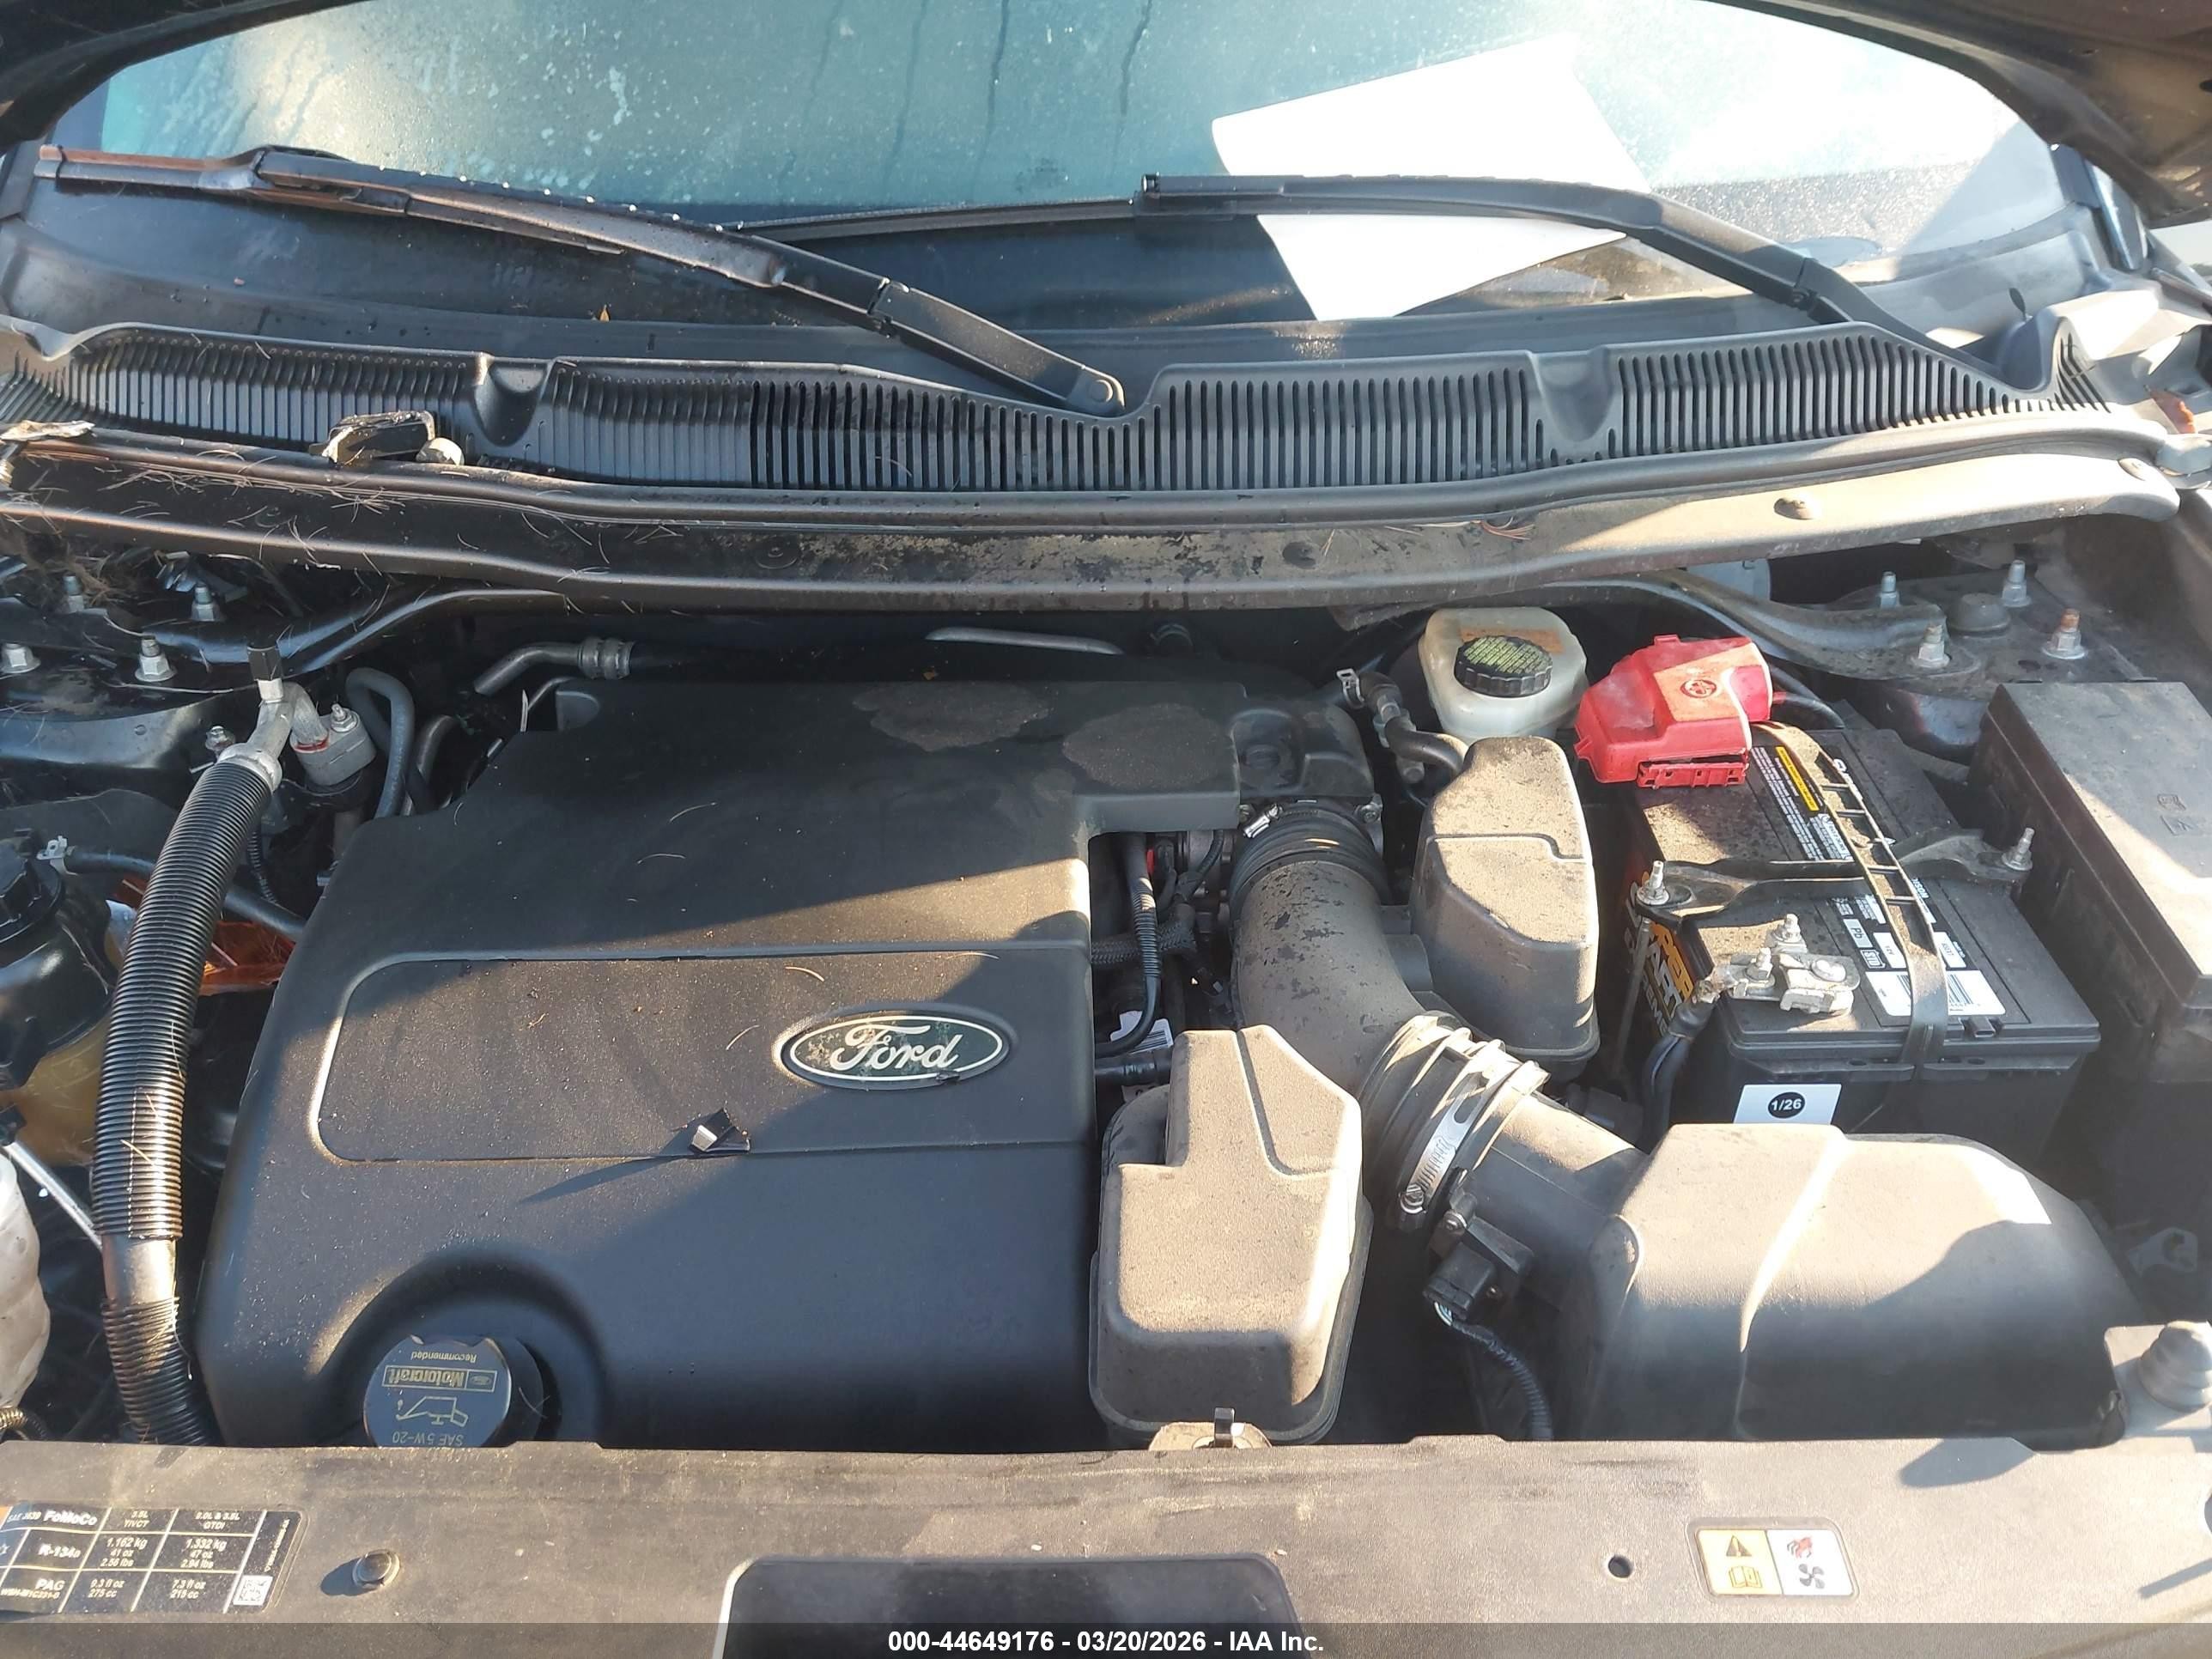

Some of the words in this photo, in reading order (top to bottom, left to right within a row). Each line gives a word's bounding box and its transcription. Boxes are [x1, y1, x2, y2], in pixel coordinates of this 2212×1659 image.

[1850, 927, 1864, 939] Pb
[830, 1024, 963, 1071] Ford
[1771, 1098, 1802, 1111] 1/26
[410, 1351, 477, 1364] Recommended
[388, 1369, 465, 1388] Motorcraft
[392, 1431, 436, 1444] 5W-20
[440, 1432, 465, 1446] SAE
[44, 1510, 98, 1526] FoMoCo
[106, 1537, 134, 1547] 1.162
[134, 1537, 149, 1550] kg
[35, 1578, 65, 1590] PAG
